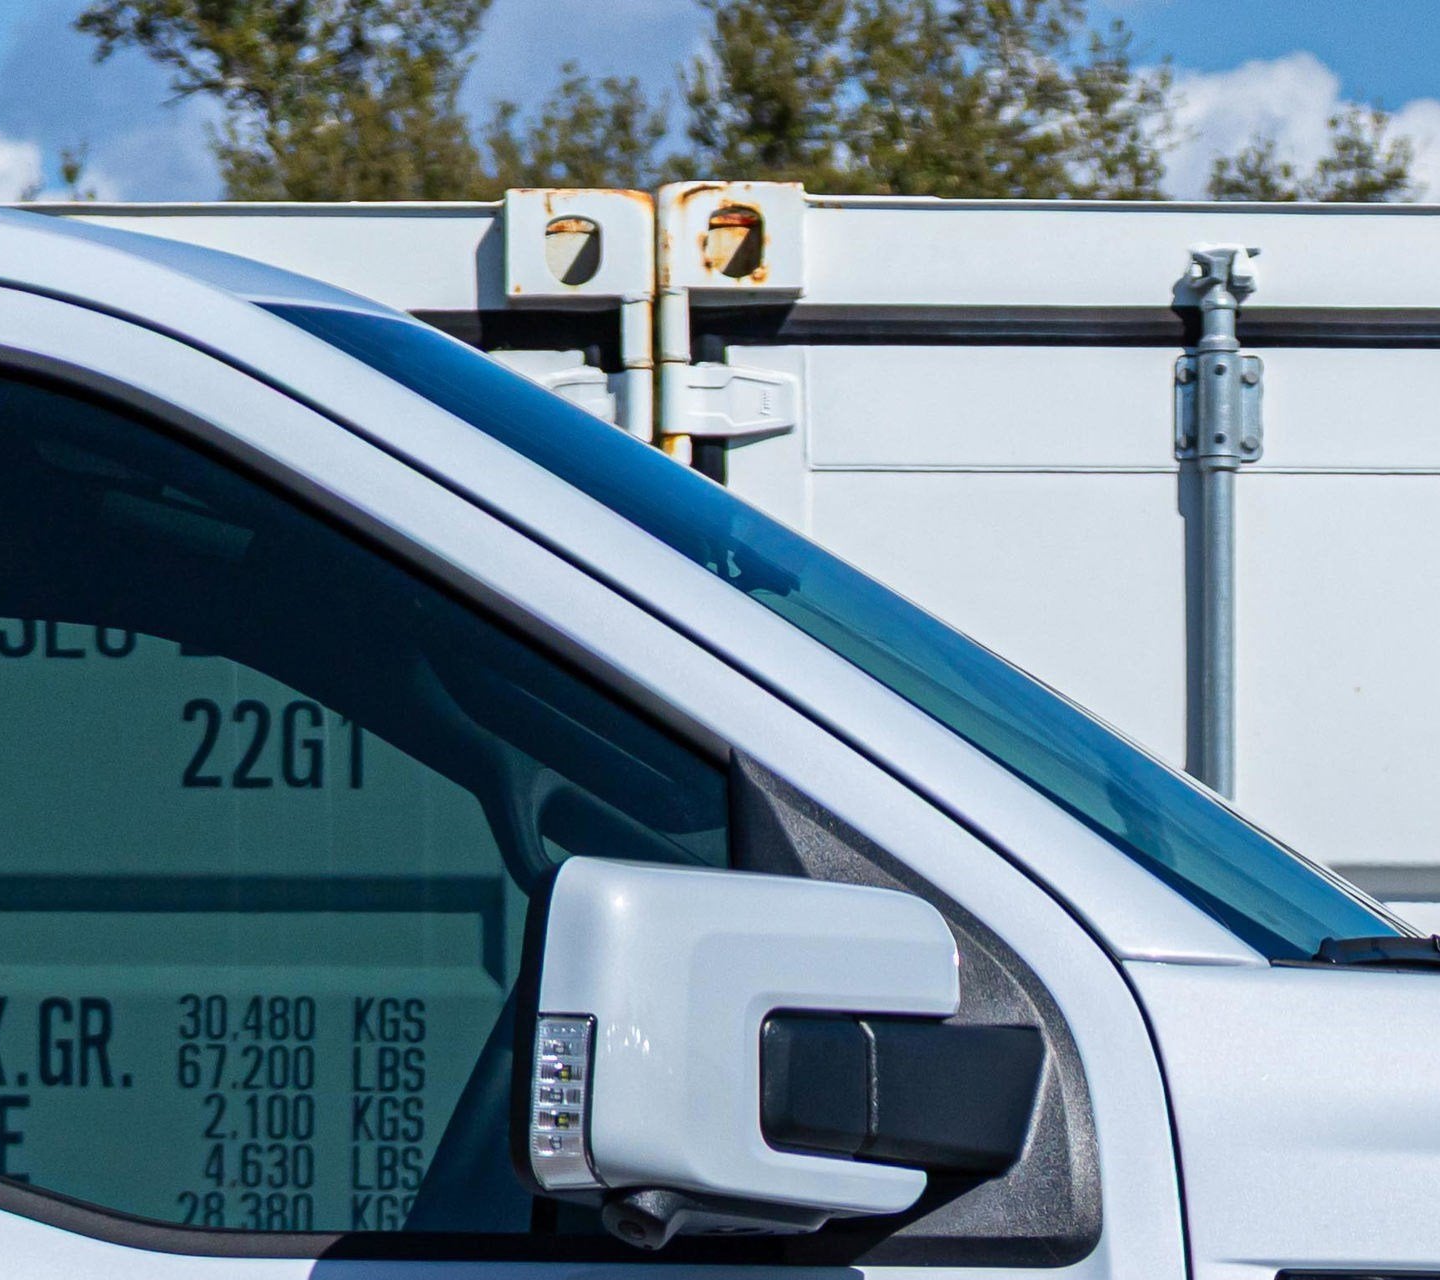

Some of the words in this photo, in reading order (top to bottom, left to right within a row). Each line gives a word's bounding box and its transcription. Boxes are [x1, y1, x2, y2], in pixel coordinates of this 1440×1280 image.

[181, 698, 363, 789] 22G1
[353, 996, 426, 1043] KGS
[353, 1047, 426, 1092] LBS
[353, 1095, 425, 1142] KGS
[353, 1146, 423, 1191] LBS
